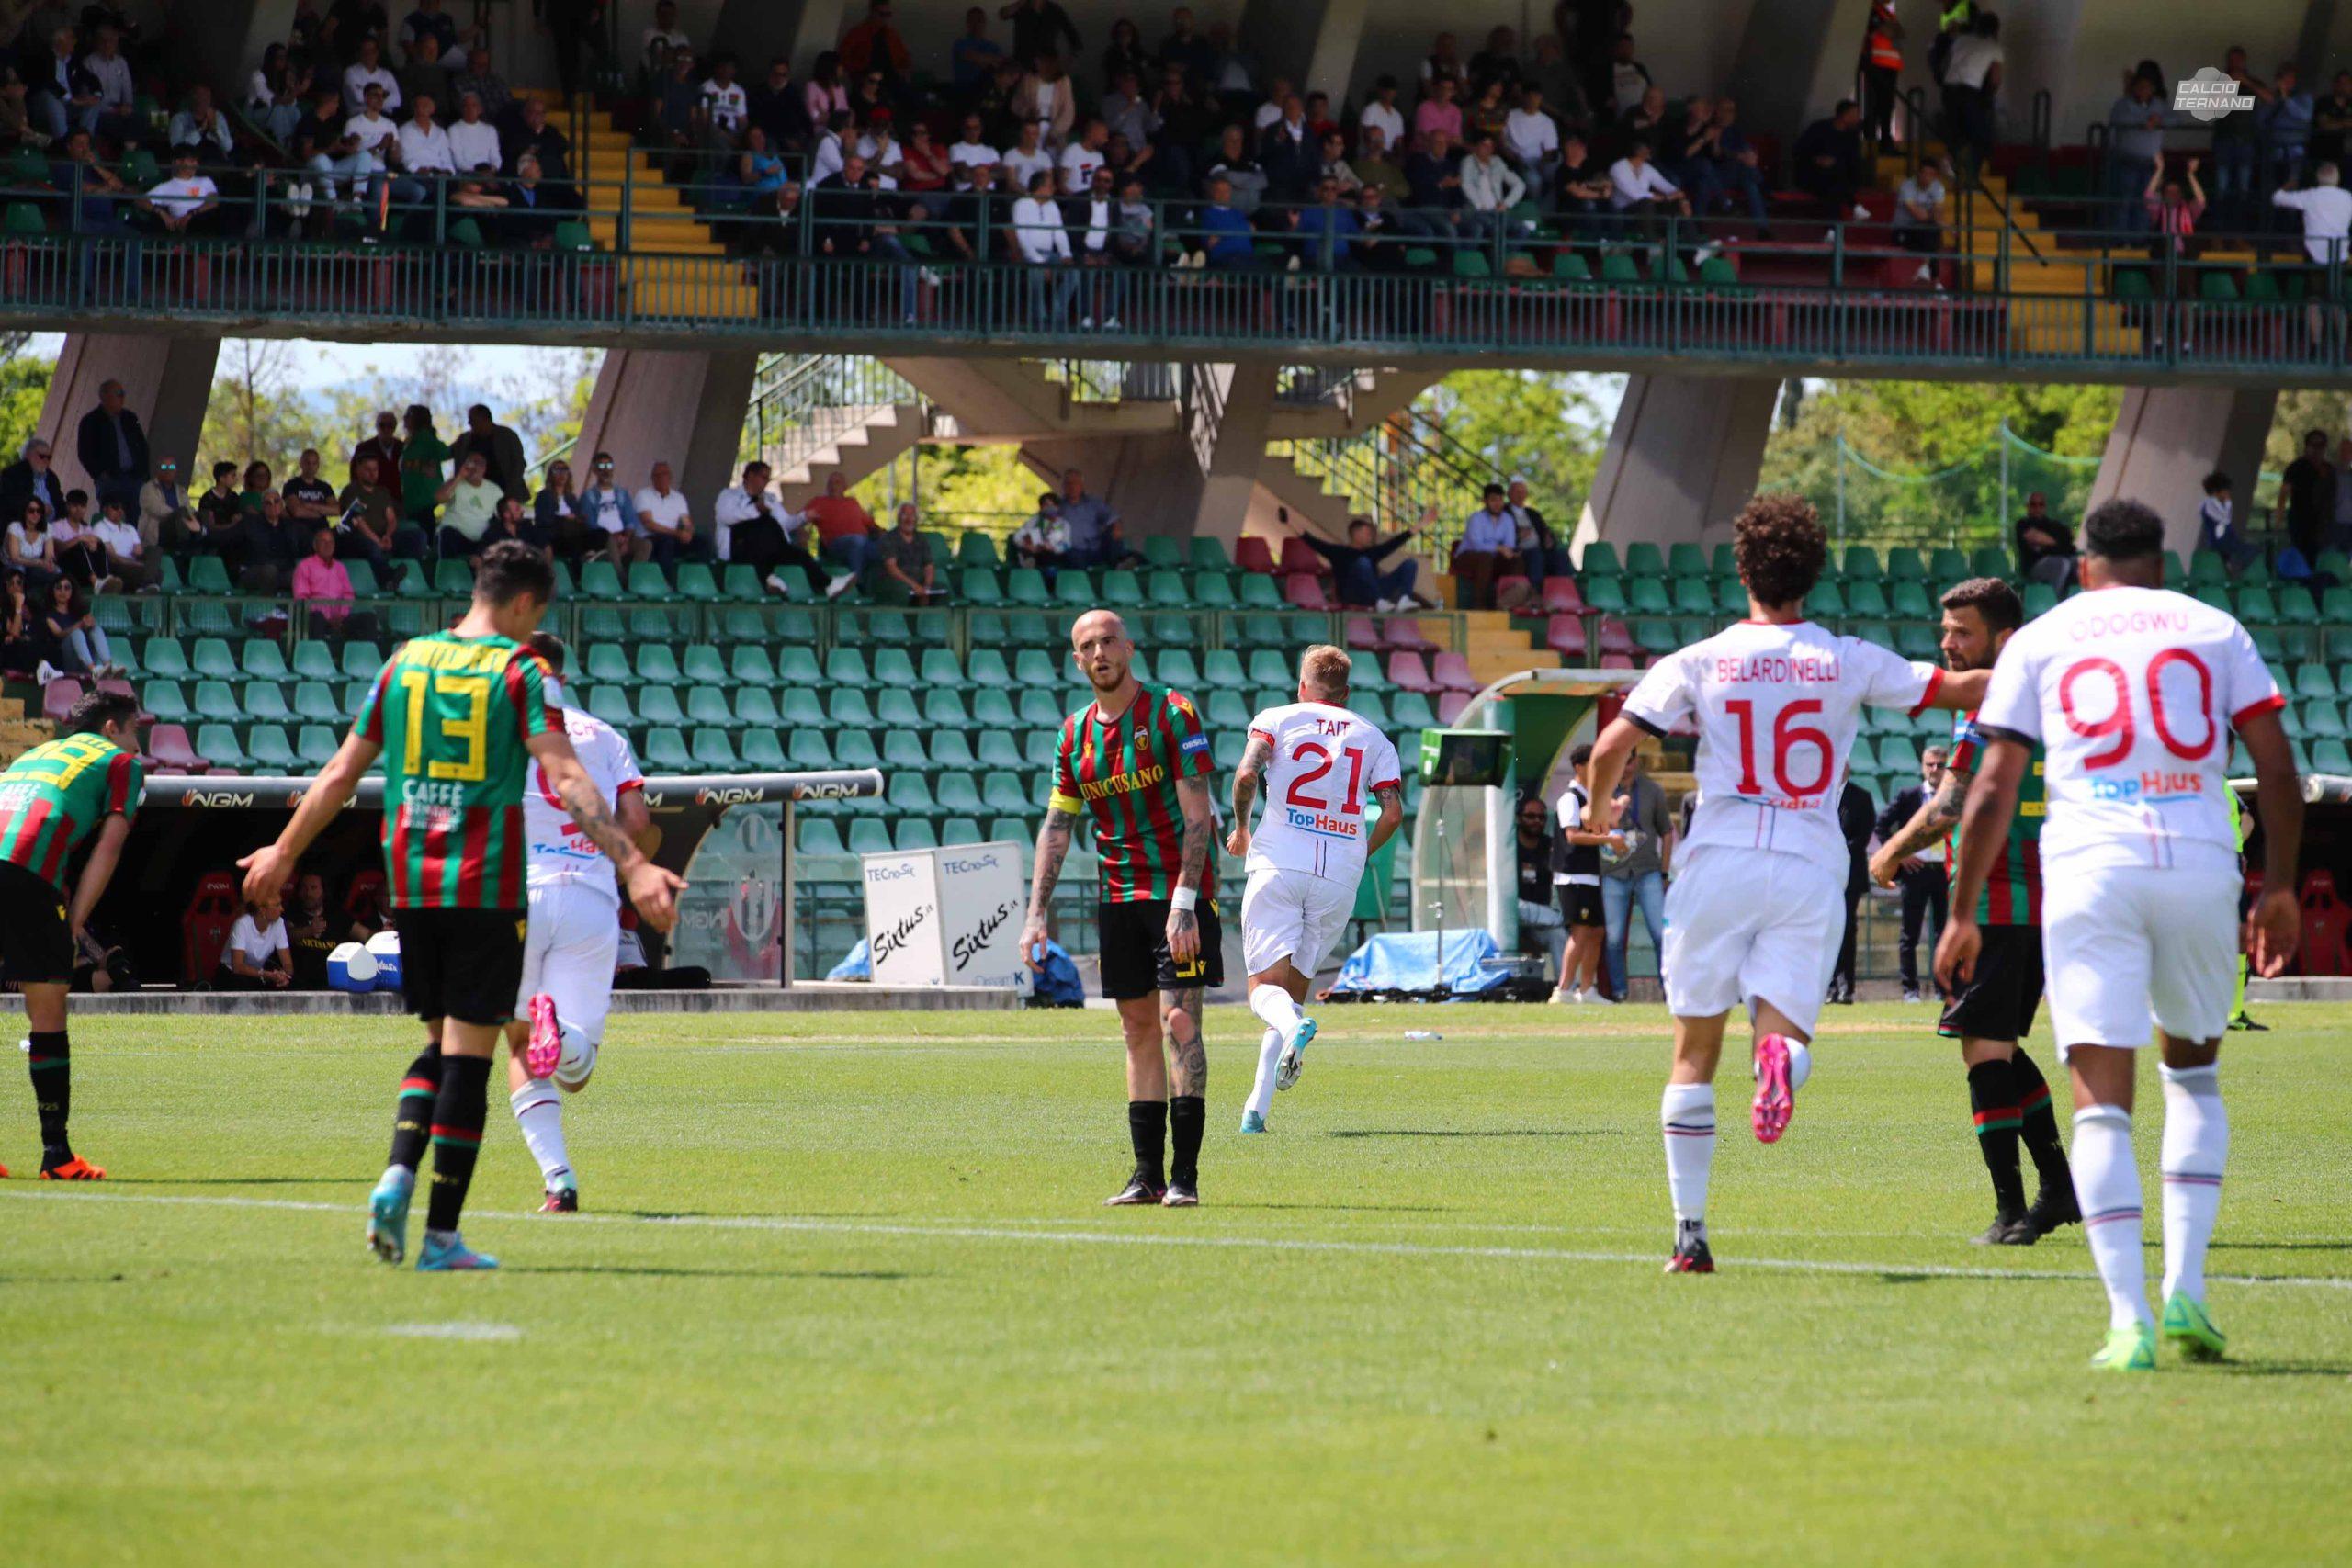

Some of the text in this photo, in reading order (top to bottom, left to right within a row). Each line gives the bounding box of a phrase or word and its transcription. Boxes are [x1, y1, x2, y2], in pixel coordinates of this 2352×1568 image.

[2070, 611, 2188, 641] ODOGWU
[1717, 656, 1841, 682] BELARDINELLI
[2059, 648, 2217, 770] 90
[401, 671, 491, 781] 13
[1317, 719, 1351, 736] TAIT
[1725, 699, 1835, 798] 16
[800, 783, 860, 800] NGM
[1079, 764, 1164, 802] UNICUSANO
[1286, 742, 1363, 815] 21
[189, 792, 254, 807] NGM
[703, 786, 764, 806] NGM
[1287, 808, 1357, 835] TopHaus
